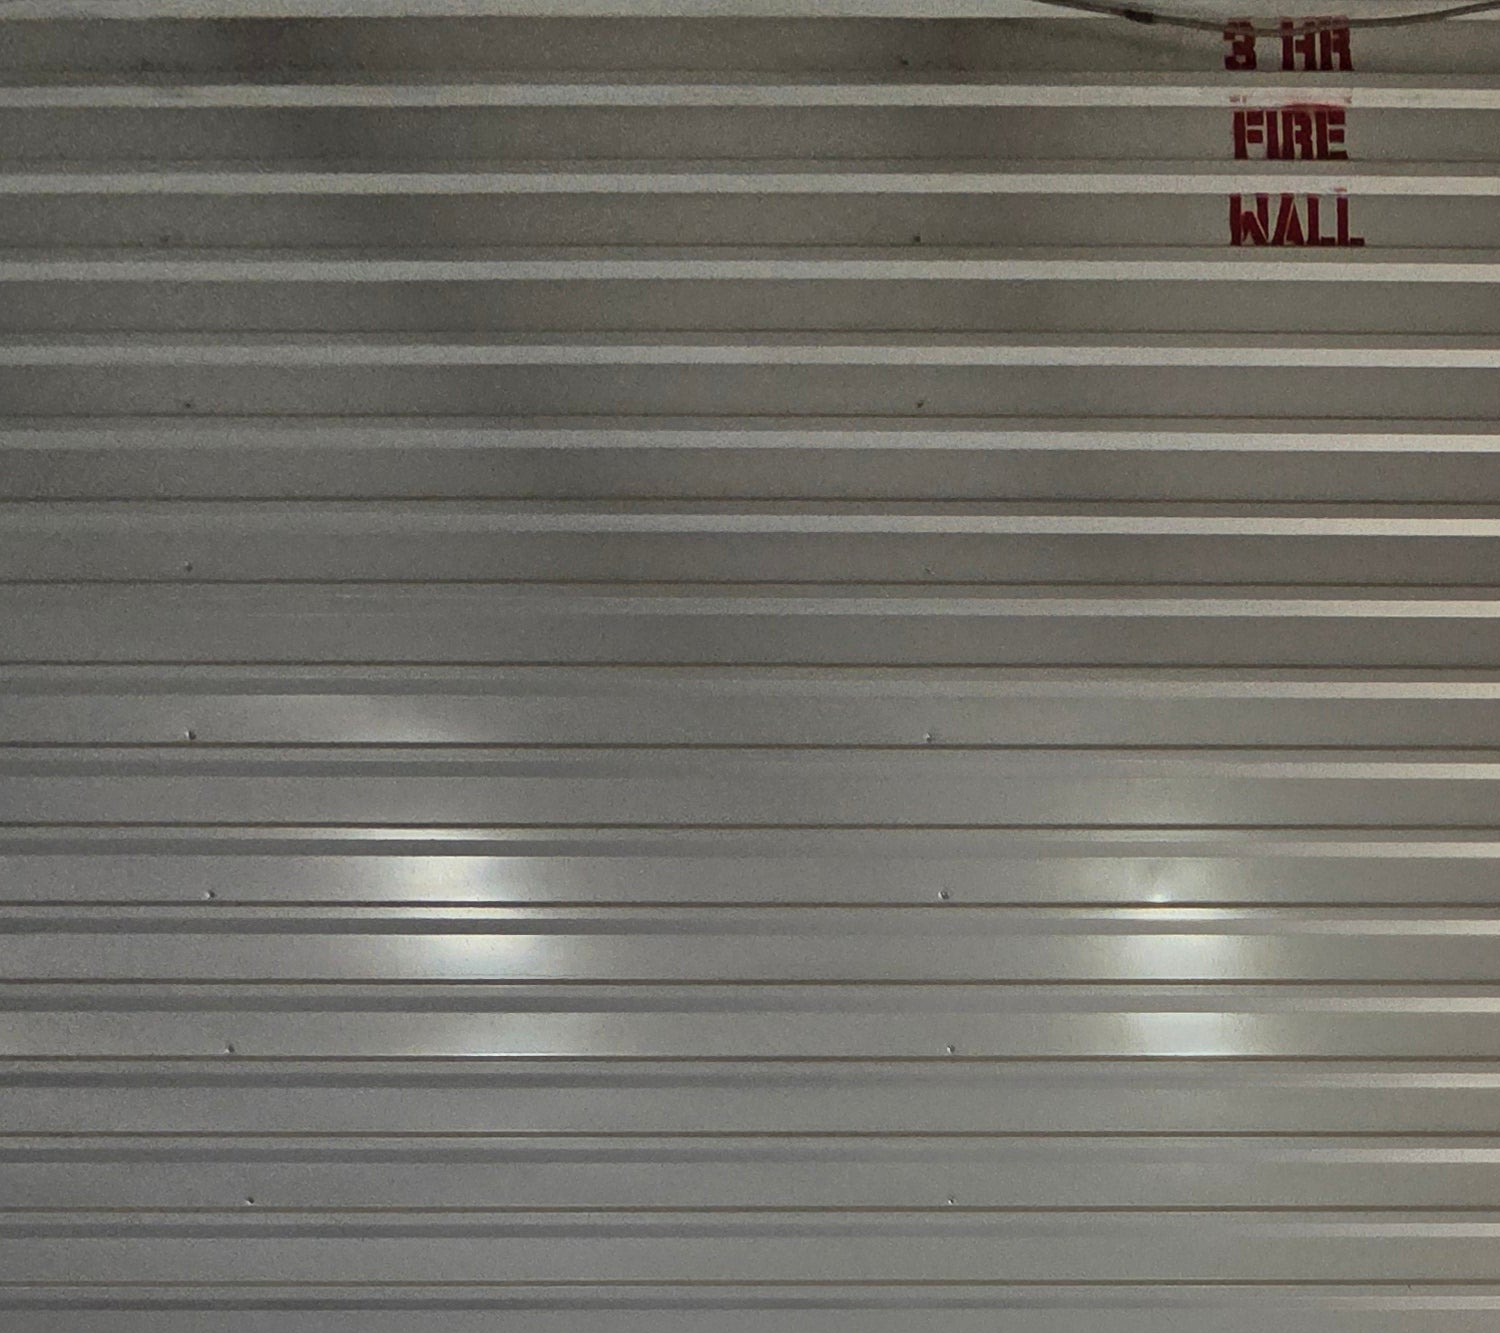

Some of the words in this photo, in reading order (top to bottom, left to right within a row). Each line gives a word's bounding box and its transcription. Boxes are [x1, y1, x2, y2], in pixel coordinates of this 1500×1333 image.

[1223, 18, 1257, 71] 3
[1280, 16, 1355, 71] HR
[1231, 103, 1350, 160] FIRE
[1229, 190, 1366, 247] WALL
